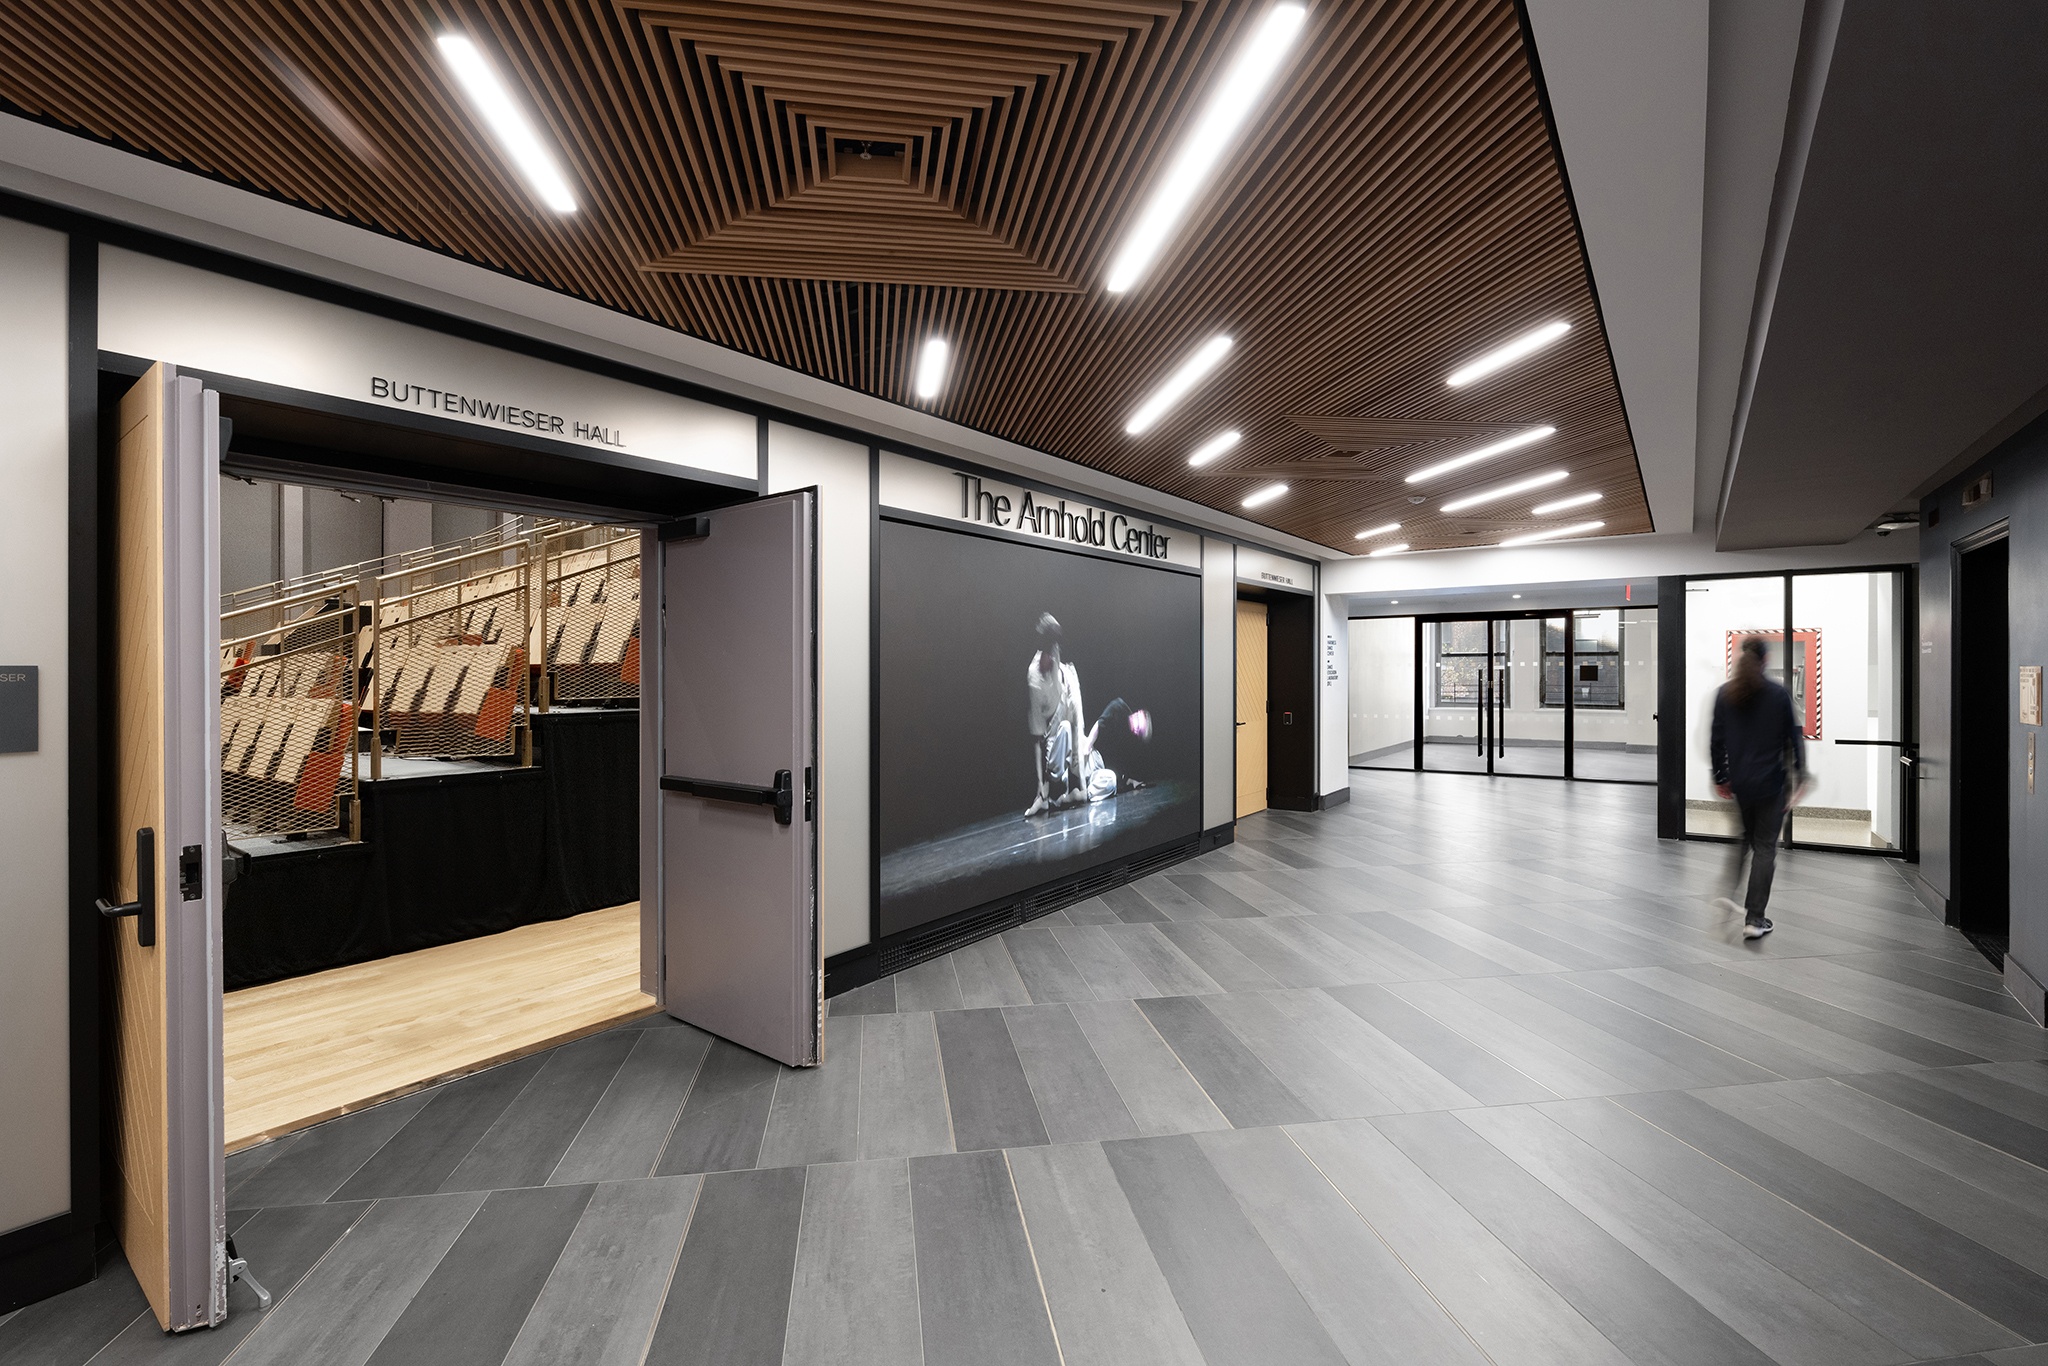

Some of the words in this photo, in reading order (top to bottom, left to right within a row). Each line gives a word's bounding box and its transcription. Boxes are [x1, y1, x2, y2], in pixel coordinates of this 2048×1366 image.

[371, 376, 564, 435] BUTTENWIESER
[573, 421, 627, 448] HALL
[952, 472, 1012, 527] The
[1016, 489, 1106, 547] Arnhold
[1110, 514, 1171, 560] Center
